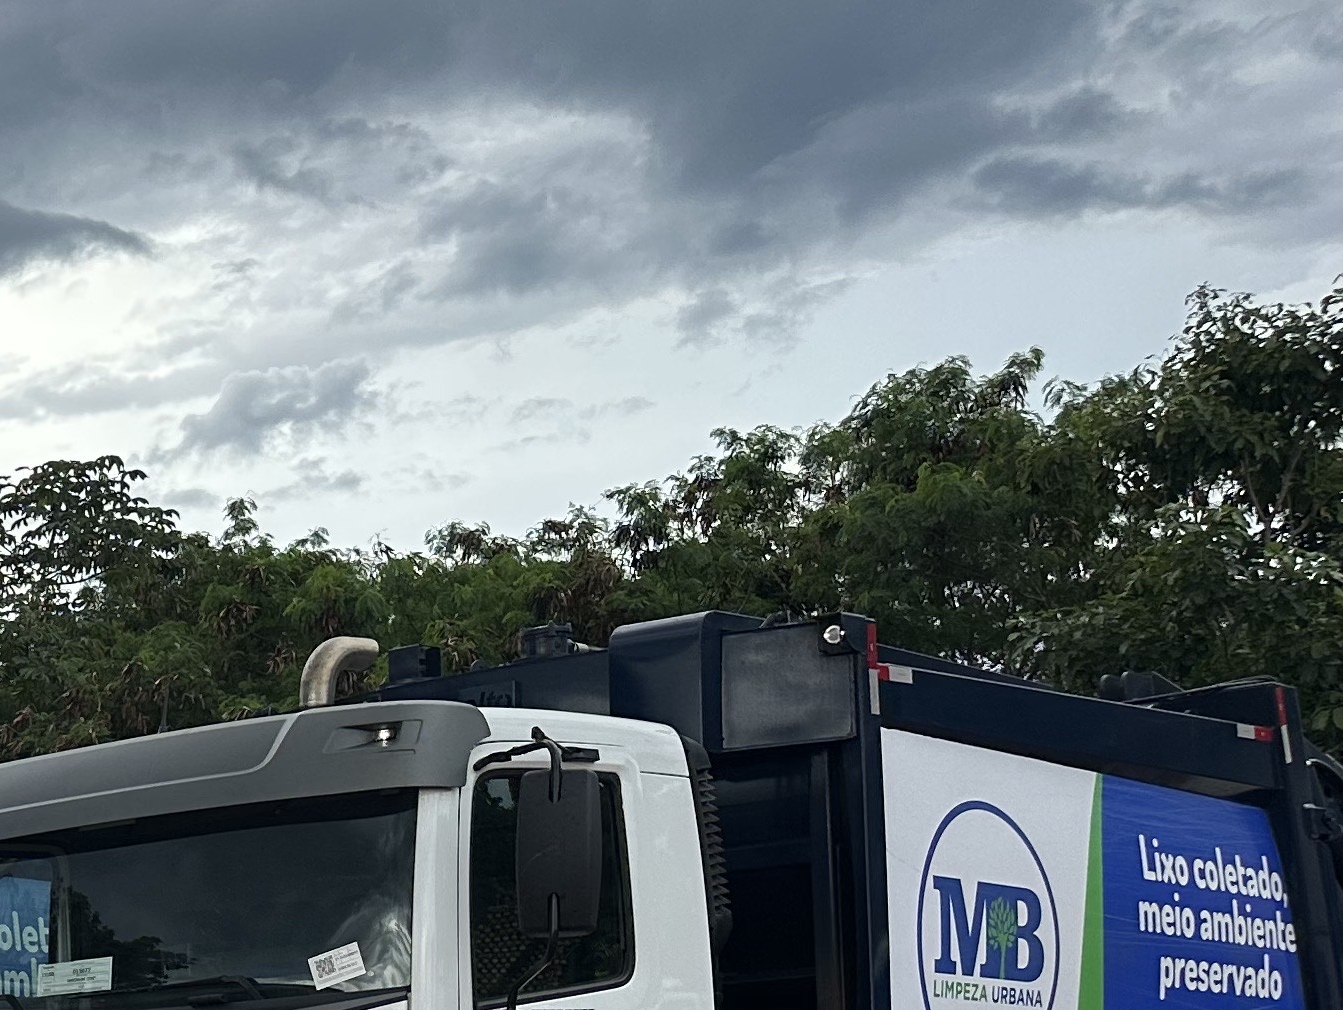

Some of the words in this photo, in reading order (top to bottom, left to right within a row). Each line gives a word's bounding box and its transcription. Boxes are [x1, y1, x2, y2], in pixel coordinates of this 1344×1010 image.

[1139, 834, 1189, 885] Lixo
[1193, 847, 1288, 908] coletado,
[933, 875, 1045, 983] MB
[1139, 892, 1195, 938] meio
[1199, 899, 1297, 953] ambiente
[933, 980, 988, 1002] LIMPEZA
[992, 985, 1043, 1008] URBANA
[1159, 954, 1283, 1000] preservado
